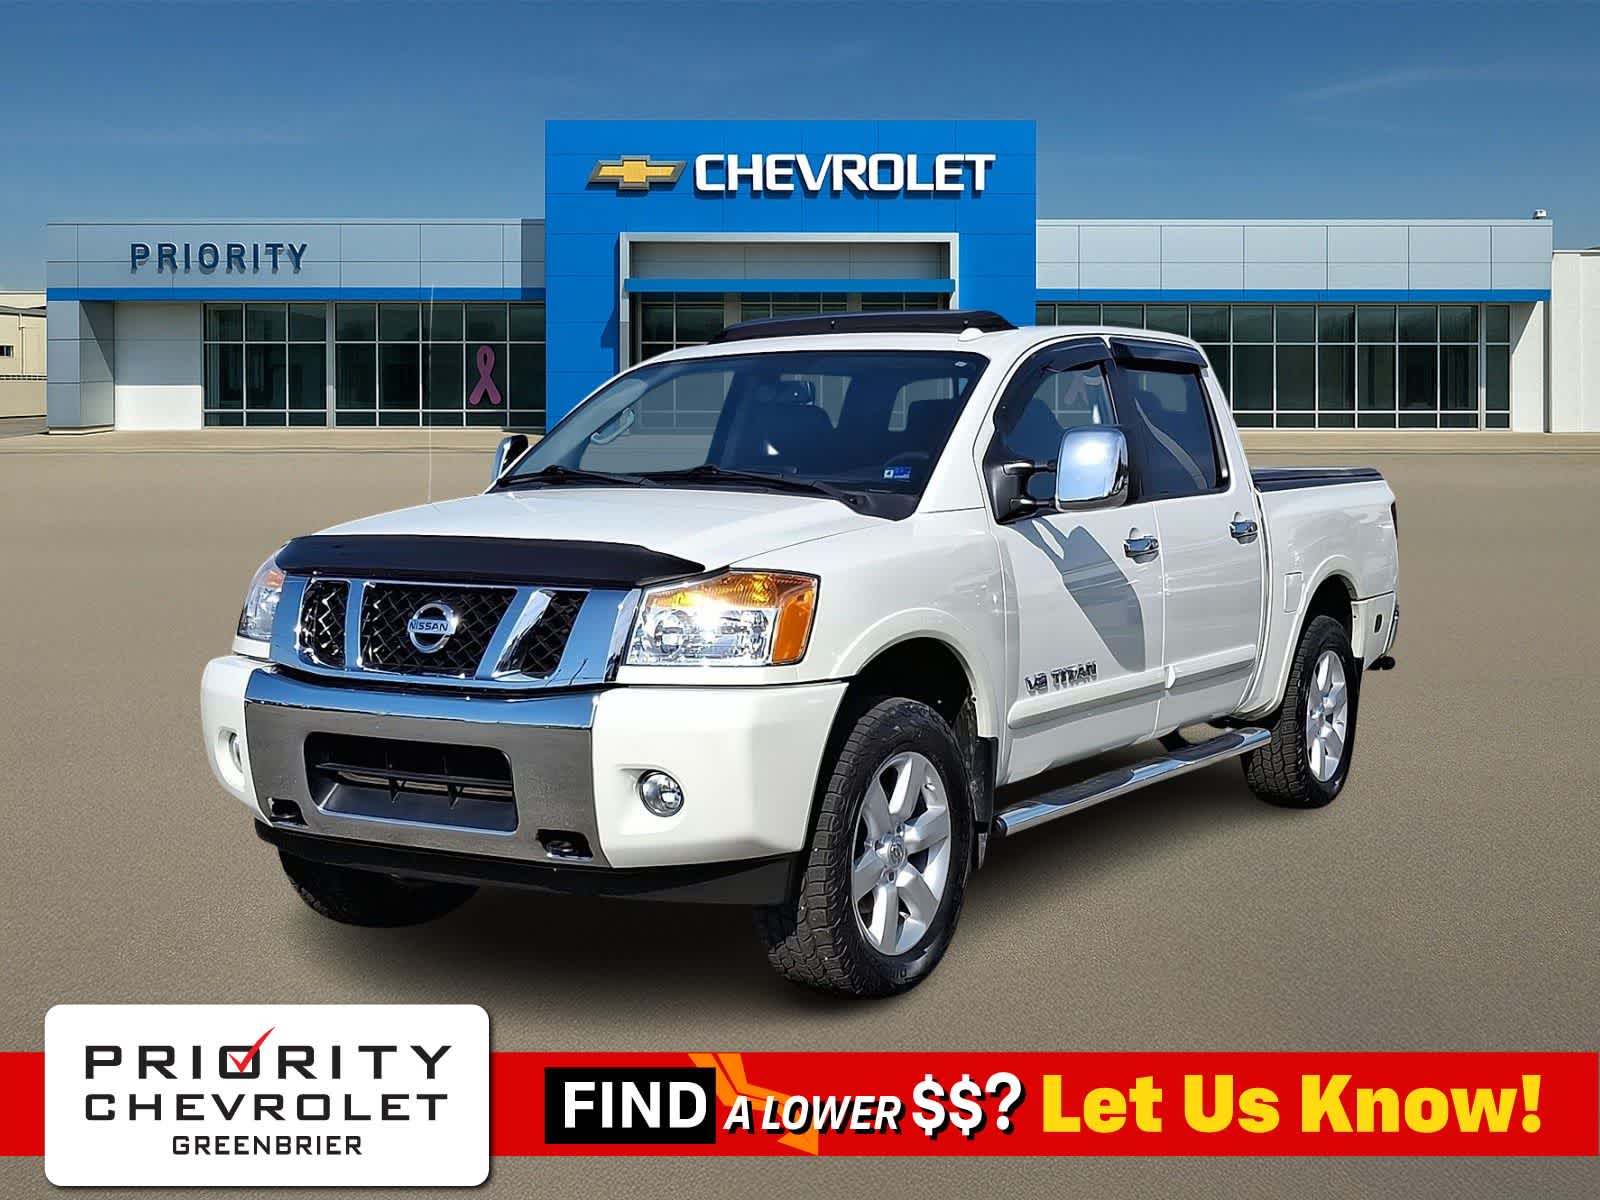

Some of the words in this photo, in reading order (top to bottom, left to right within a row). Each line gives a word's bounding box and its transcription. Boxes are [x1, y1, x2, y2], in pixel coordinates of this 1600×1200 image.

[694, 153, 997, 192] CHEVROLET
[130, 242, 308, 272] PRIORITY
[409, 621, 449, 632] NISSAN
[1050, 660, 1097, 688] TITAN
